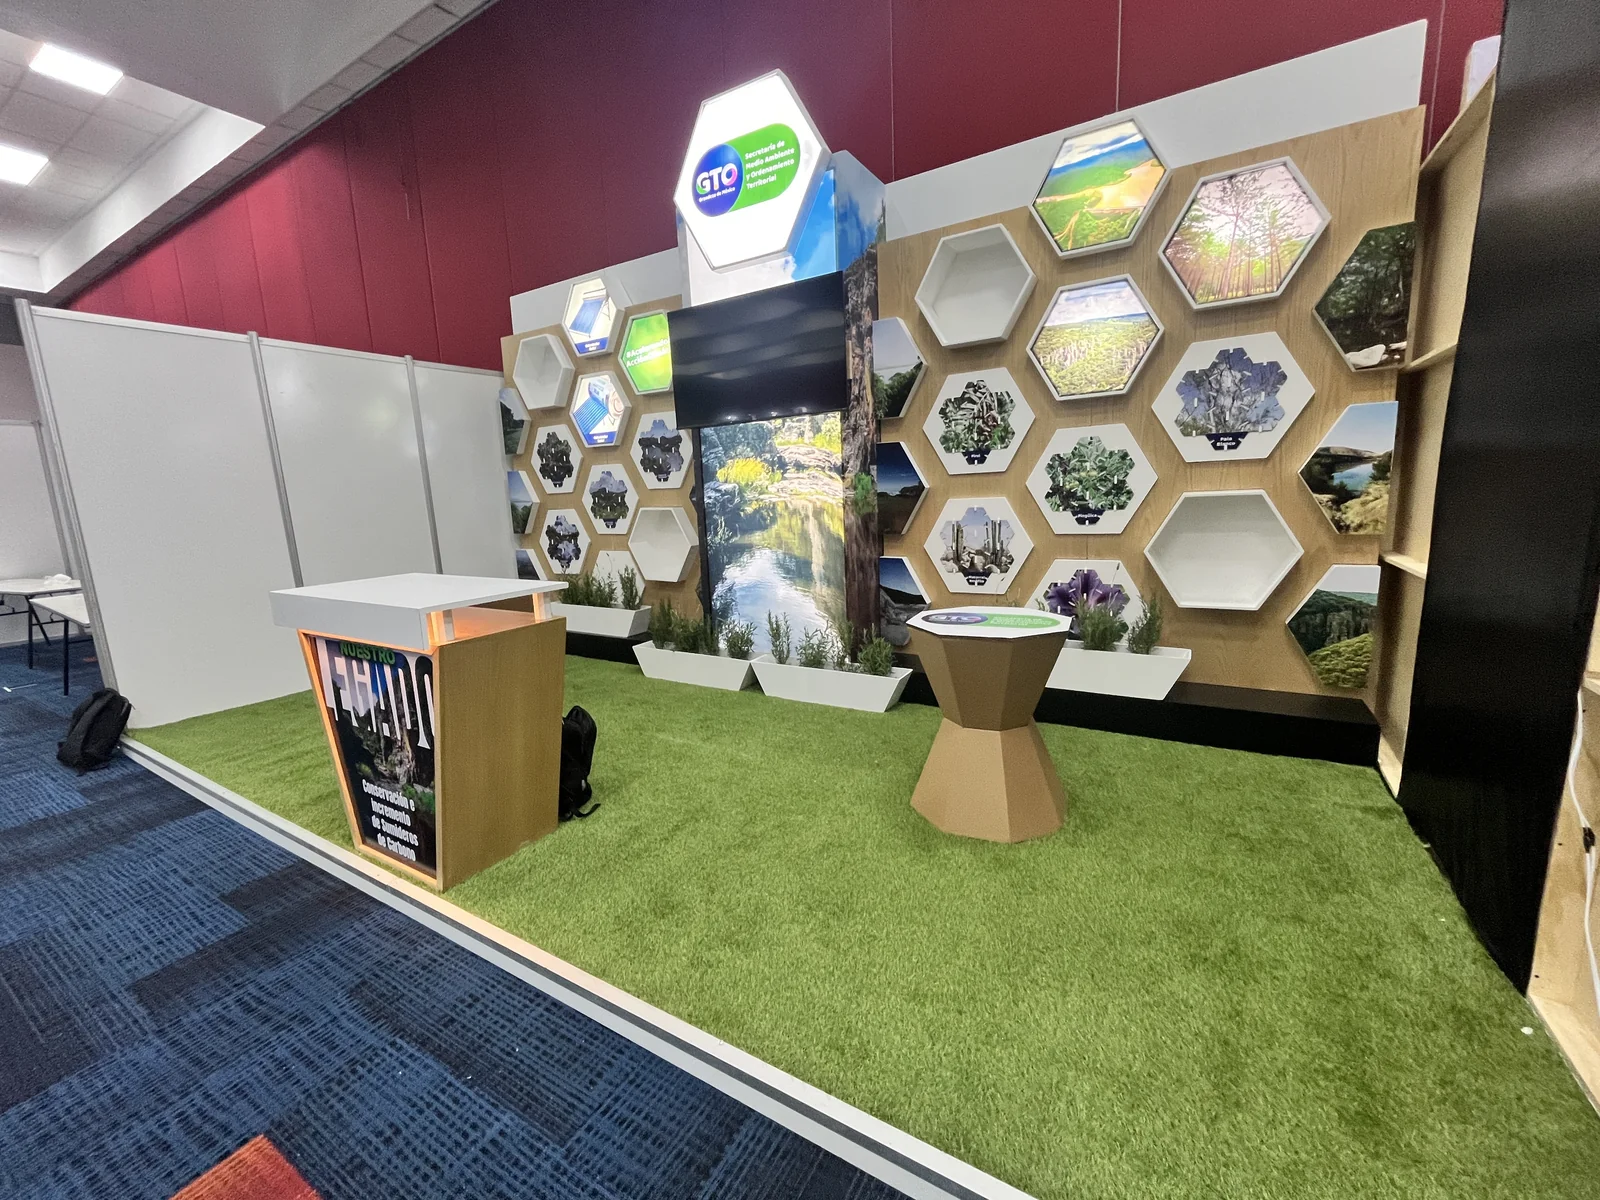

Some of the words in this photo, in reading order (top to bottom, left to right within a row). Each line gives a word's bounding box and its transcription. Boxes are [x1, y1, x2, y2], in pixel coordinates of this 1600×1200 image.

[745, 142, 776, 160] Secretaría
[776, 140, 786, 149] de
[745, 159, 764, 170] Medio
[764, 147, 795, 163] Ambiente
[696, 162, 738, 195] GTO
[745, 173, 751, 182] y
[750, 158, 795, 178] Ordenamiento
[746, 173, 777, 189] Territorial
[340, 641, 396, 665] NUESTRO
[316, 638, 436, 750] EGADO
[362, 778, 410, 810] Conservación
[409, 799, 416, 812] e
[370, 797, 412, 827] incremento
[371, 814, 381, 830] de
[380, 818, 419, 847] Sumideros
[377, 832, 387, 848] de
[386, 836, 417, 862] Carbono
